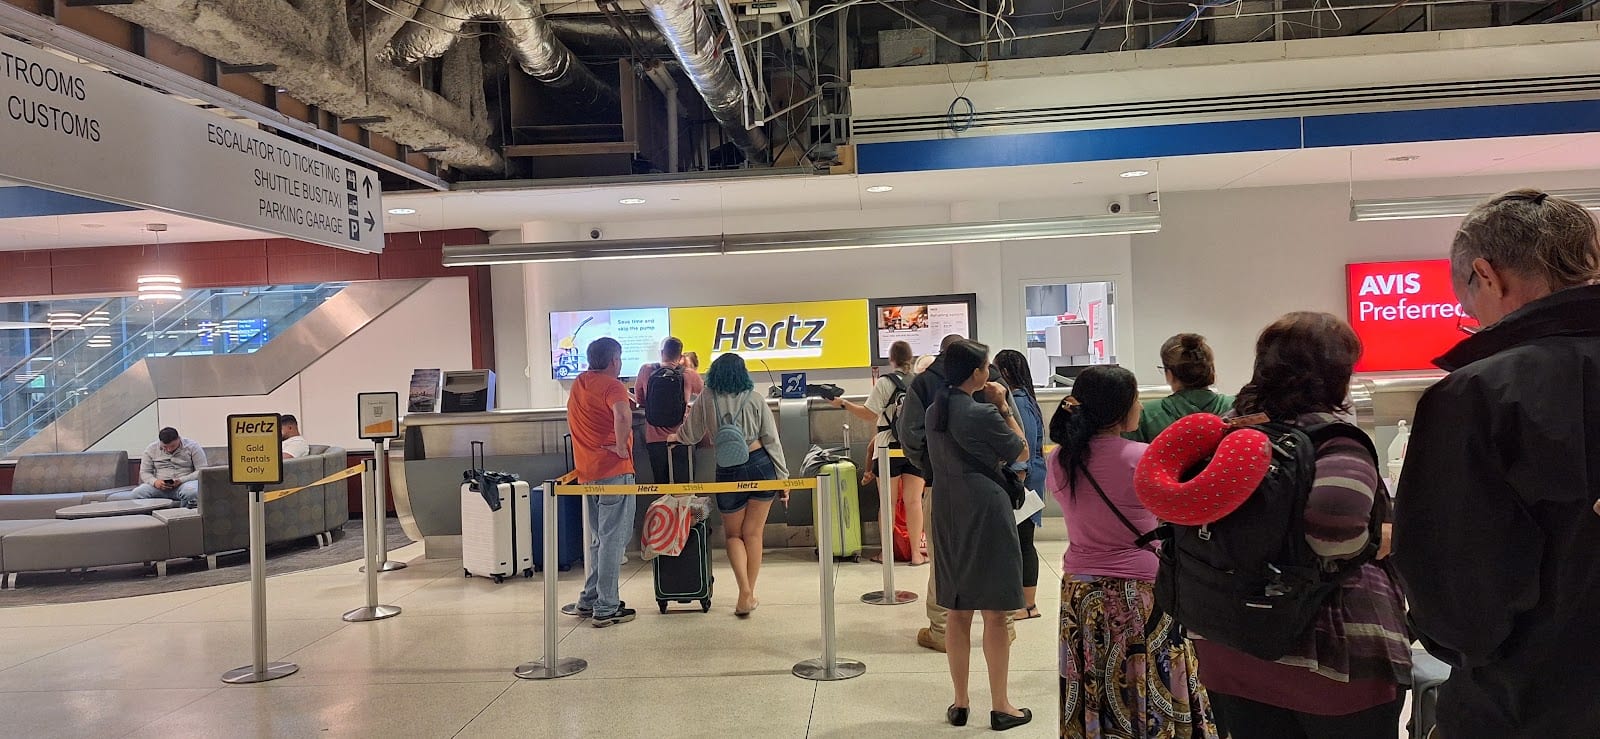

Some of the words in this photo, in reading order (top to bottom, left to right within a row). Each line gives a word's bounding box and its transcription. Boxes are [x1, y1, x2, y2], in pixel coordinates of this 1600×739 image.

[0, 52, 86, 101] TROOMS
[8, 95, 101, 142] CUSTOMS
[207, 123, 275, 162] ESCALATOR
[277, 147, 291, 168] TO
[293, 152, 341, 183] TICKETING
[254, 168, 300, 198] SHUTTLE
[302, 183, 342, 209] BUS/TAXI
[259, 199, 303, 225] PARKING
[305, 210, 343, 235] GARAGE
[1359, 273, 1421, 296] AVIS
[711, 314, 827, 351] Hertz
[235, 420, 275, 434] Hertz
[240, 455, 271, 463] Rentals
[246, 444, 264, 452] Gold
[246, 465, 265, 474] Only
[637, 485, 659, 493] Hertz
[736, 481, 759, 490] Hertz
